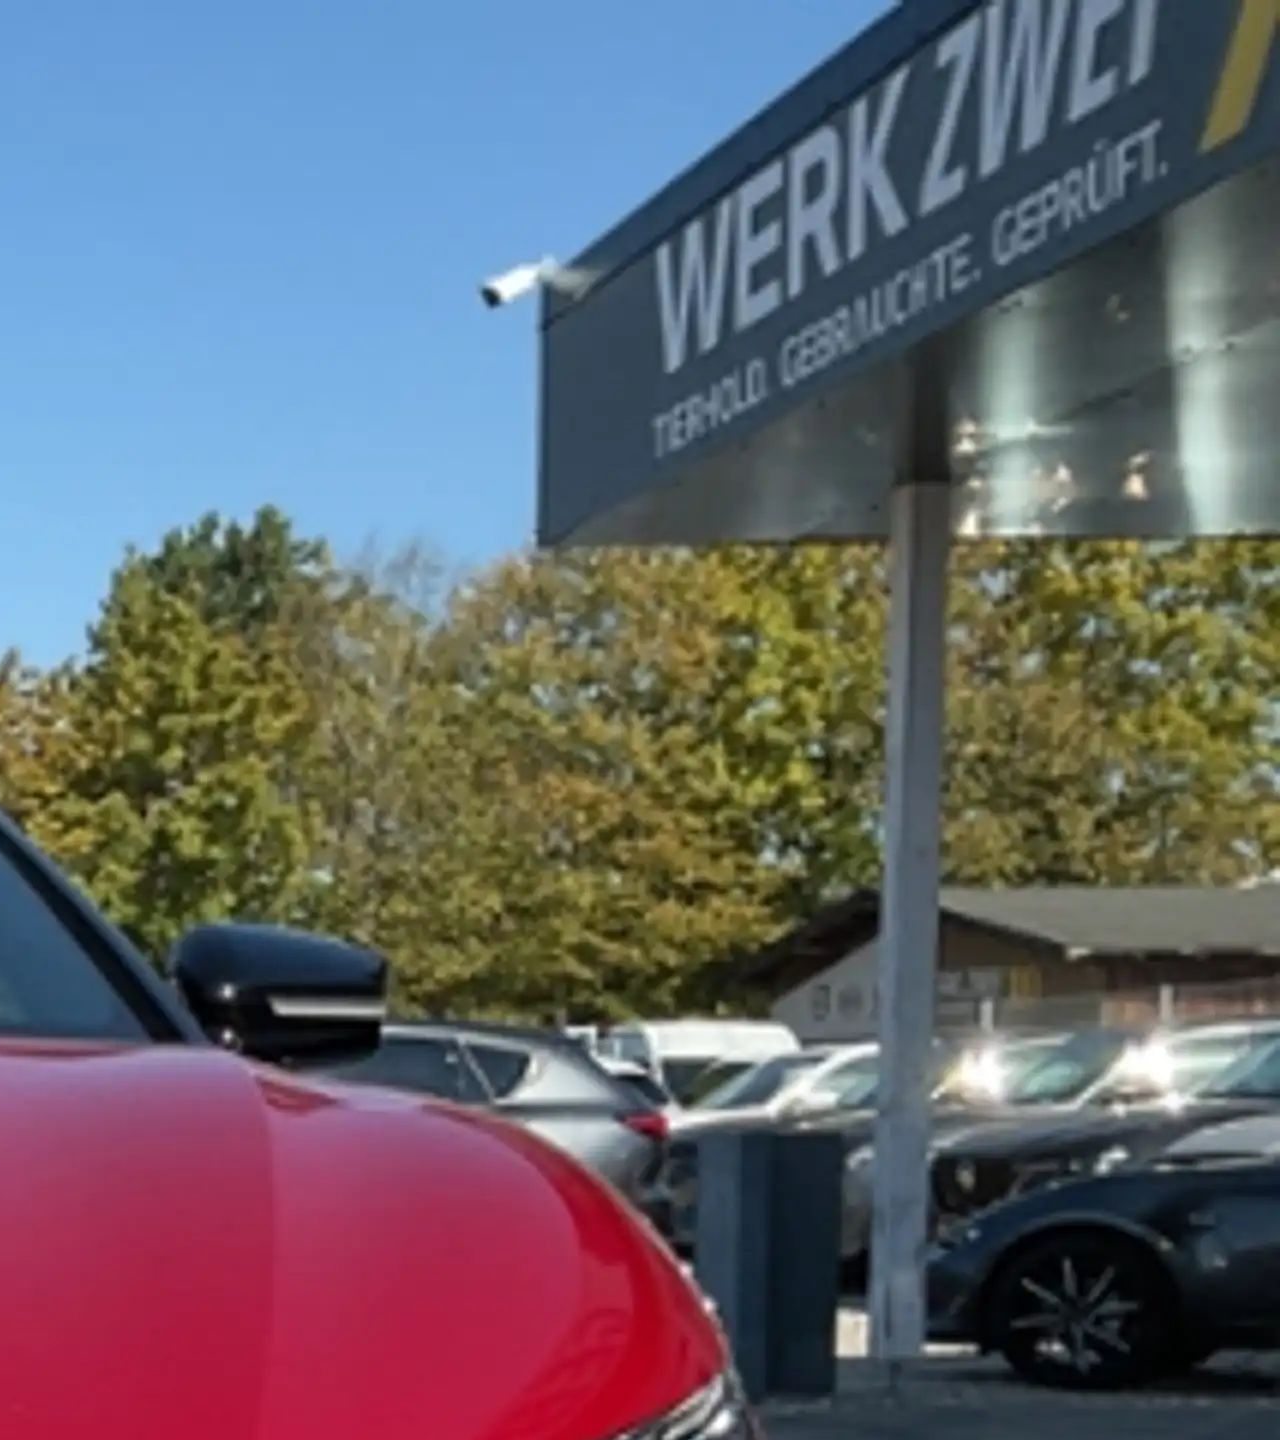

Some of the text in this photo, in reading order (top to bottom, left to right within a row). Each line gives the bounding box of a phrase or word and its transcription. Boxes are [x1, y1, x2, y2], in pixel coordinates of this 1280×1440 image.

[655, 64, 910, 374] WERK
[780, 232, 982, 387] GEBRAUCHTE.
[990, 118, 1169, 266] GEPRÜFT.
